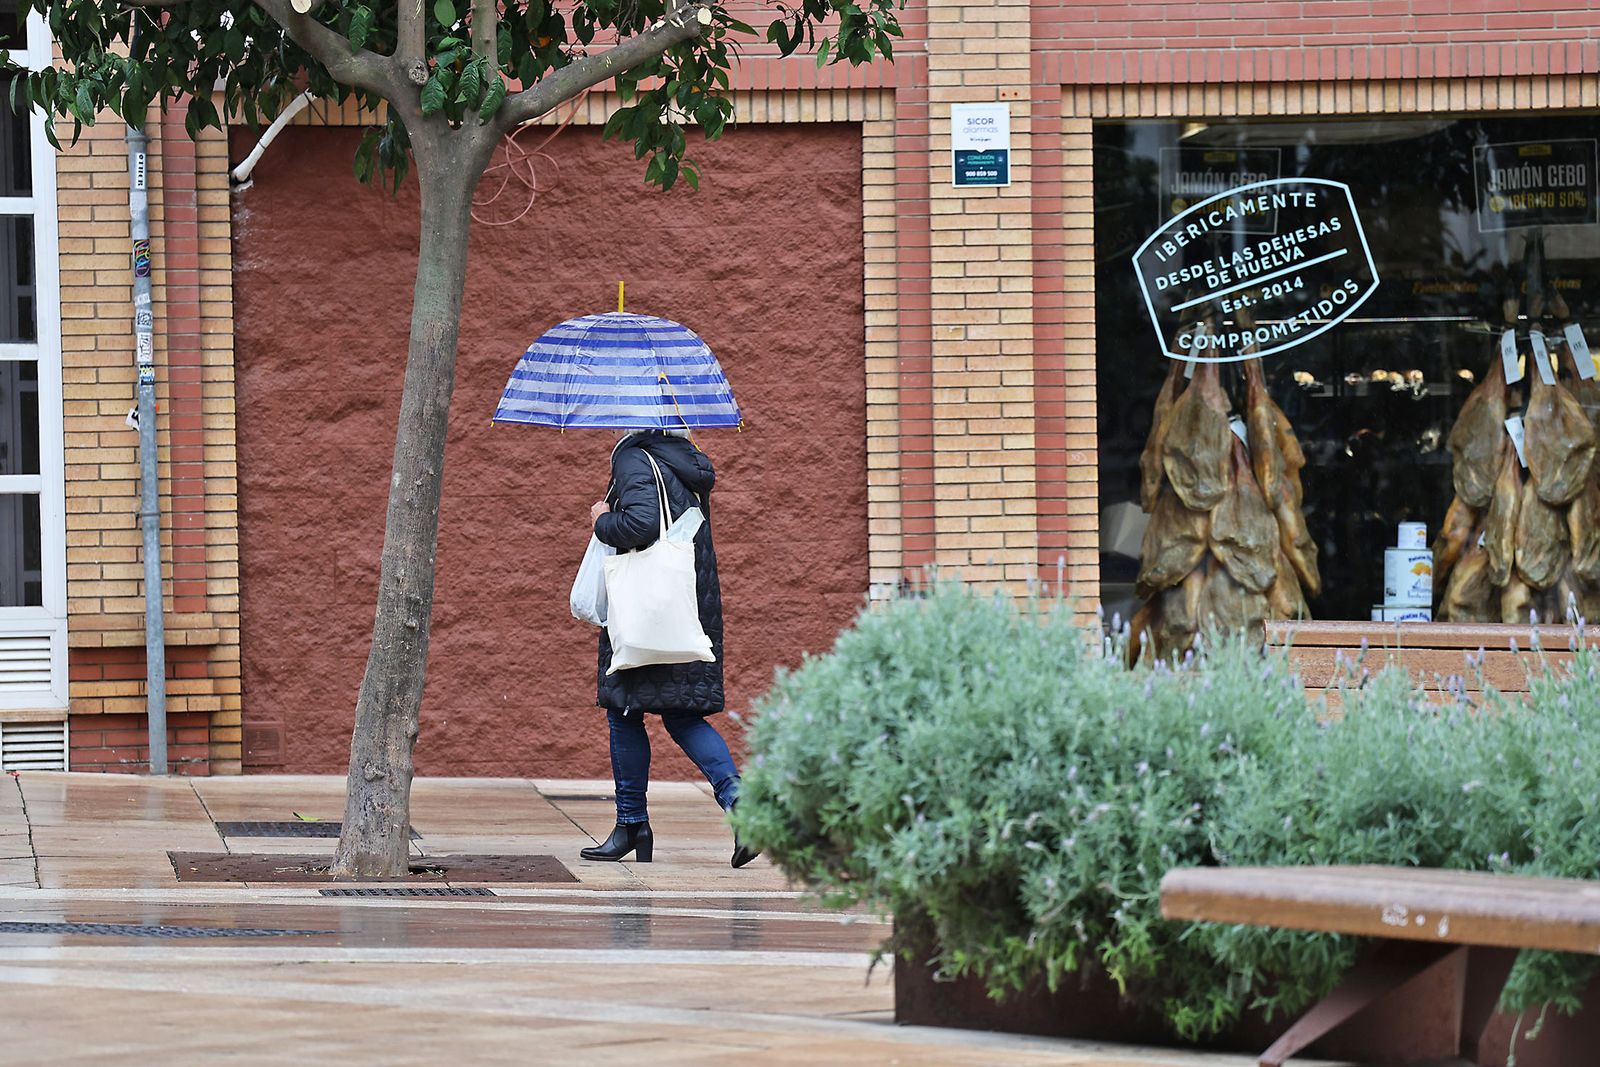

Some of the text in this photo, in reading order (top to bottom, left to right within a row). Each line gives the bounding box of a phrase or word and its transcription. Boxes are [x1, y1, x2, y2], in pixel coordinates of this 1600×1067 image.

[967, 117, 994, 125] SICOR
[1488, 161, 1586, 192] JAMÓN CEBO
[1559, 190, 1587, 208] 50%
[1154, 192, 1317, 262] IBERICAMENTE
[1155, 217, 1342, 291] DESDE LAS DEHESAS
[1206, 246, 1305, 289] DE HUELVA
[1178, 278, 1359, 350] COMPROMETIDOS
[1221, 294, 1257, 314] Est.
[1261, 276, 1305, 300] 2014
